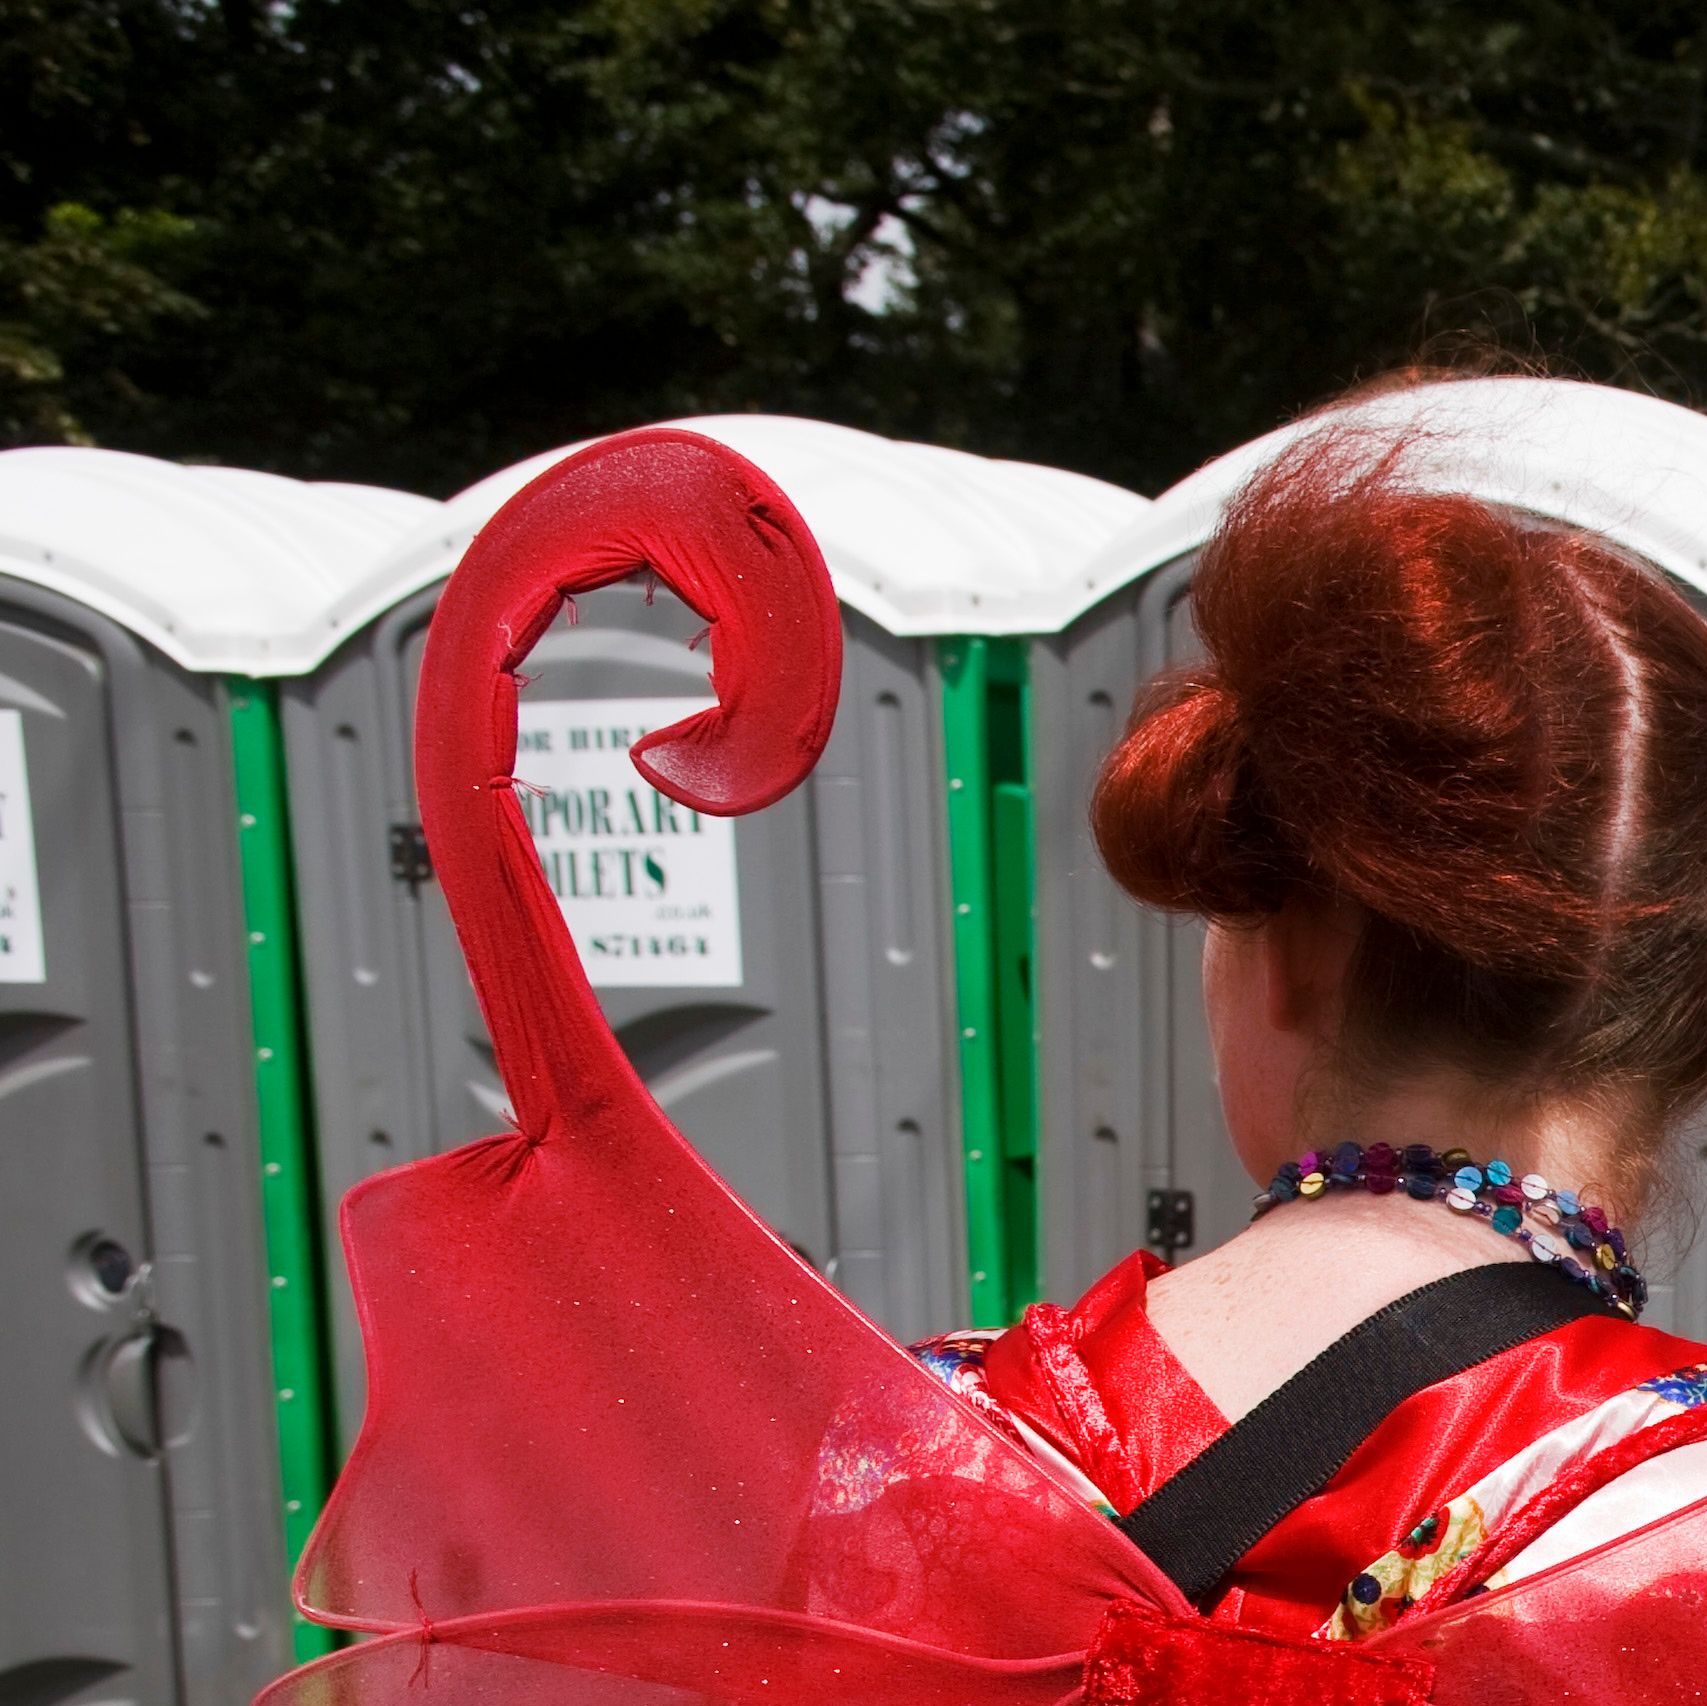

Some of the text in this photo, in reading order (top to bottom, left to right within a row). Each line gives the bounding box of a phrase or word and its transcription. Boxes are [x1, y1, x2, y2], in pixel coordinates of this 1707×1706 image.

[518, 726, 648, 752] OR HIR
[521, 788, 703, 837] PORAR
[541, 848, 669, 898] ILETS
